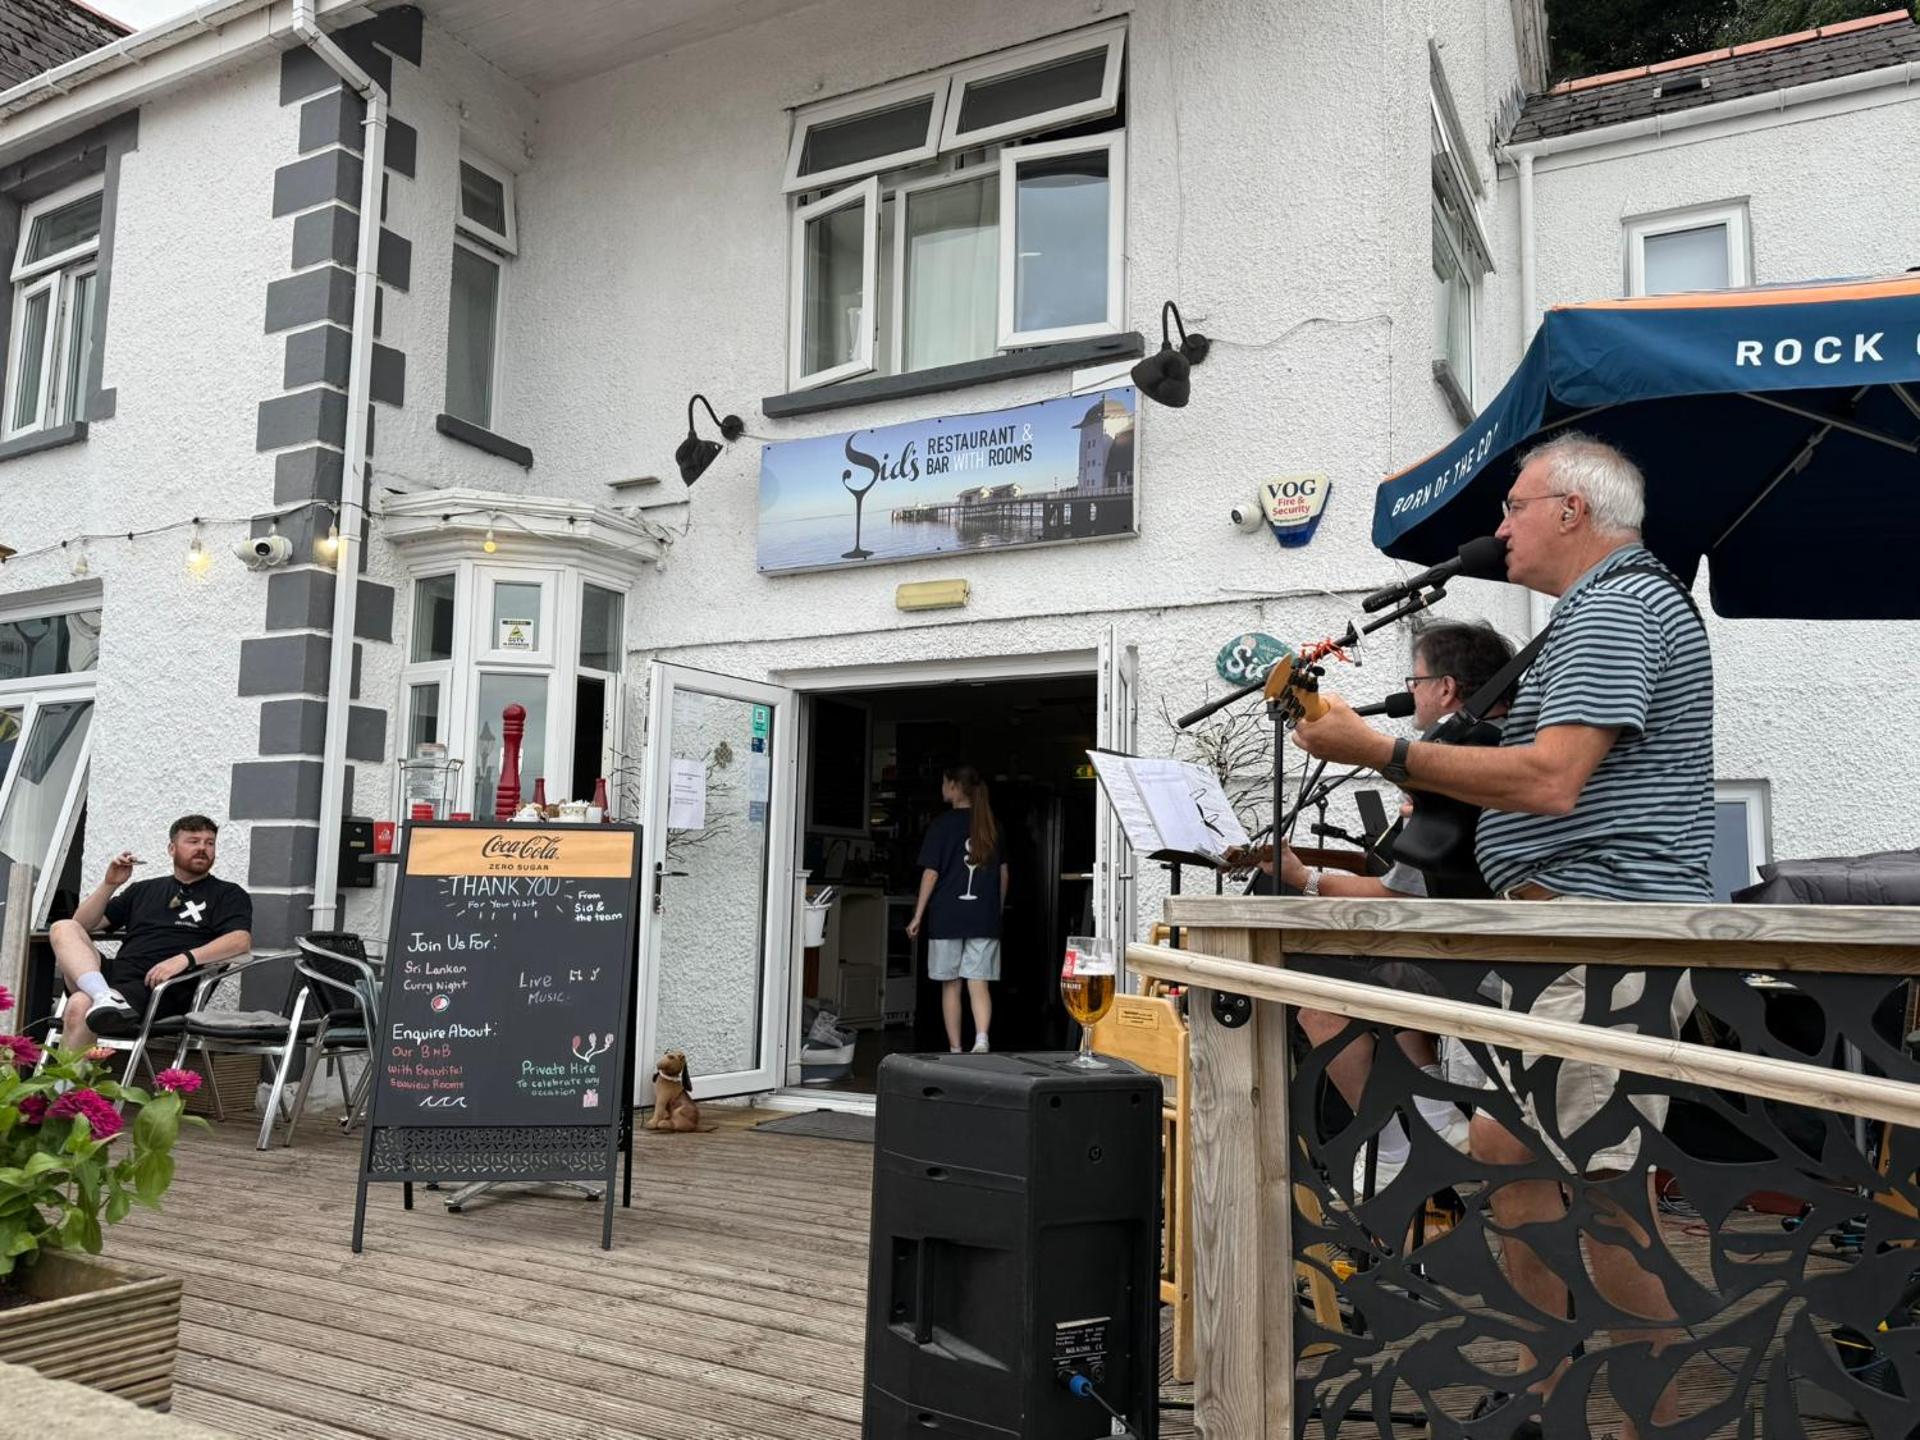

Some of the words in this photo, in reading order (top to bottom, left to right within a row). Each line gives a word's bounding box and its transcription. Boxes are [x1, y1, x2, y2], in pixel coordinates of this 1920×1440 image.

[1736, 332, 1884, 366] ROCK
[927, 425, 1016, 454] RESTAURANT
[1022, 424, 1032, 441] &
[841, 431, 919, 490] Sid's
[926, 456, 949, 475] BAR
[953, 452, 984, 472] WITH
[988, 444, 1032, 467] ROOMS
[1268, 480, 1316, 499] VOG
[1391, 483, 1432, 517] BORN
[1434, 469, 1450, 498] OF
[1453, 447, 1475, 485] THE
[1278, 498, 1296, 507] Fire
[1298, 496, 1304, 504] &
[1272, 505, 1311, 517] Security
[488, 863, 514, 871] ZERO
[517, 863, 549, 871] SUGAR
[449, 876, 520, 897] THANK
[525, 876, 560, 897] YOU
[578, 891, 601, 900] From
[468, 900, 485, 909] For
[597, 902, 605, 911] &
[595, 911, 623, 921] team
[407, 932, 441, 952] Join
[448, 934, 465, 951] Us
[405, 962, 421, 974] Sri
[425, 962, 467, 976] Lankan
[404, 980, 433, 993] Curry
[436, 979, 468, 994] Night
[519, 972, 552, 988] Live
[392, 1023, 446, 1045] Enquire
[392, 1046, 412, 1057] Our
[416, 1065, 463, 1077] Beautiful
[522, 1060, 565, 1075] Private
[570, 1062, 596, 1074] Hire
